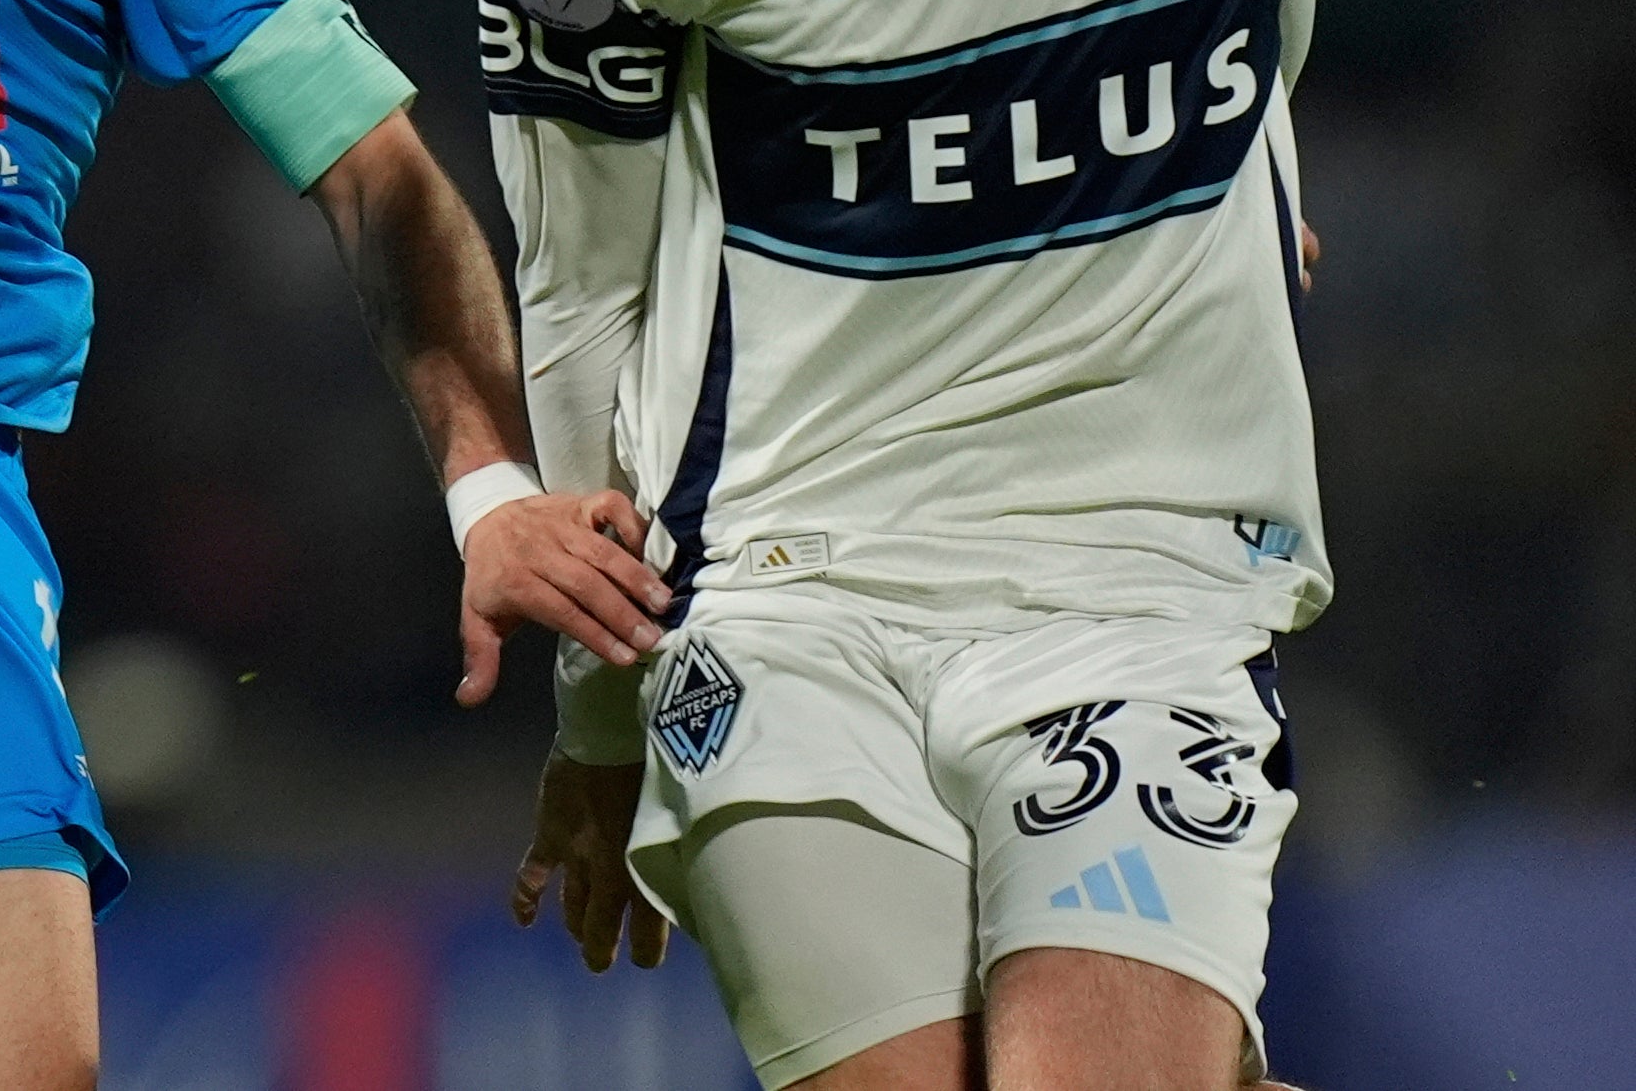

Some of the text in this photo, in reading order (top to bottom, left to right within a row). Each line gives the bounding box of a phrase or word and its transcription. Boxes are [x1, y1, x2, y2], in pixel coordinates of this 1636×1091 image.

[804, 28, 1257, 204] TELUS
[657, 686, 737, 727] WHITECAPS
[689, 714, 706, 731] FC
[1013, 700, 1256, 850] 33
